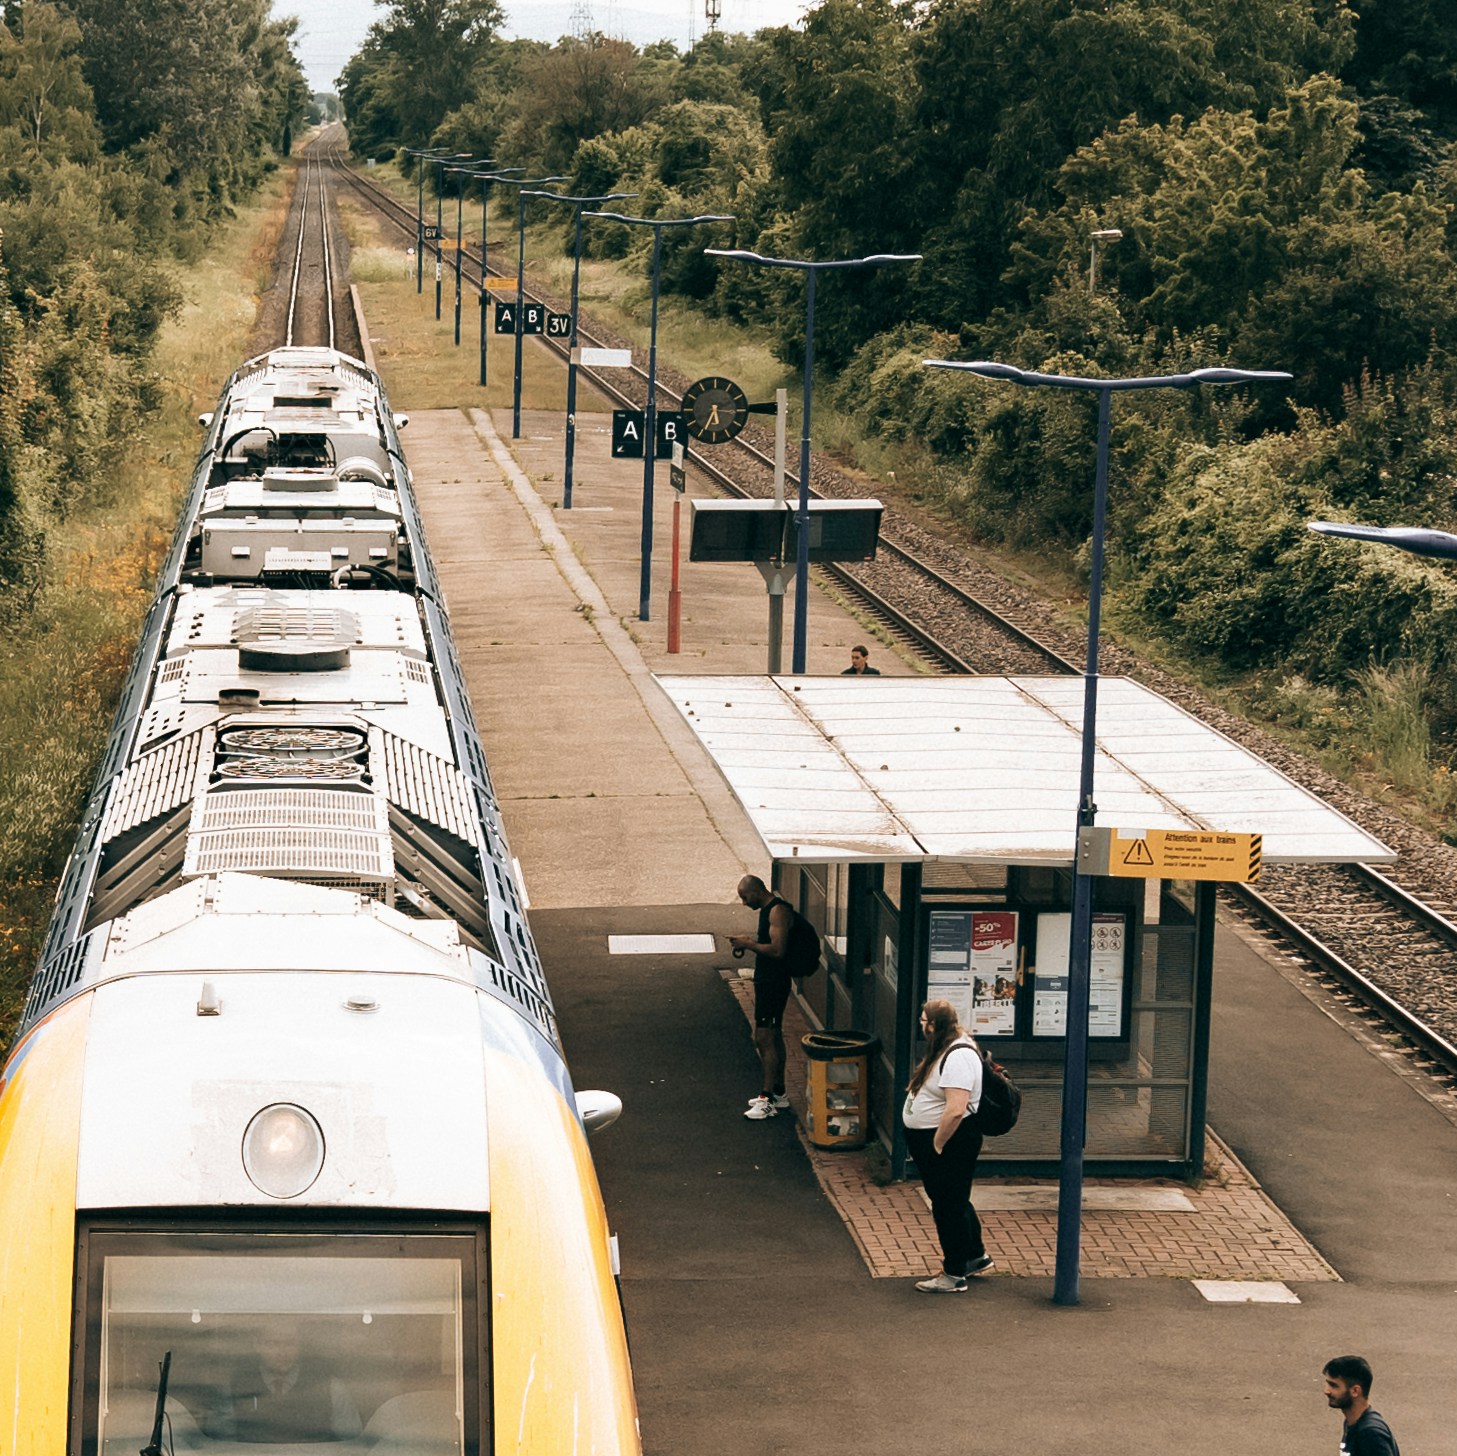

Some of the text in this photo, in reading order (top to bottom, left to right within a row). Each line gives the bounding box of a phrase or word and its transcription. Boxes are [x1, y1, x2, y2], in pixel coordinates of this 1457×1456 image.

[425, 228, 438, 238] 6V
[501, 309, 512, 322] A
[528, 309, 538, 323] B
[549, 318, 568, 333] 3V
[623, 420, 639, 440] A
[664, 421, 677, 440] B
[1164, 833, 1237, 845] Attention aux trains
